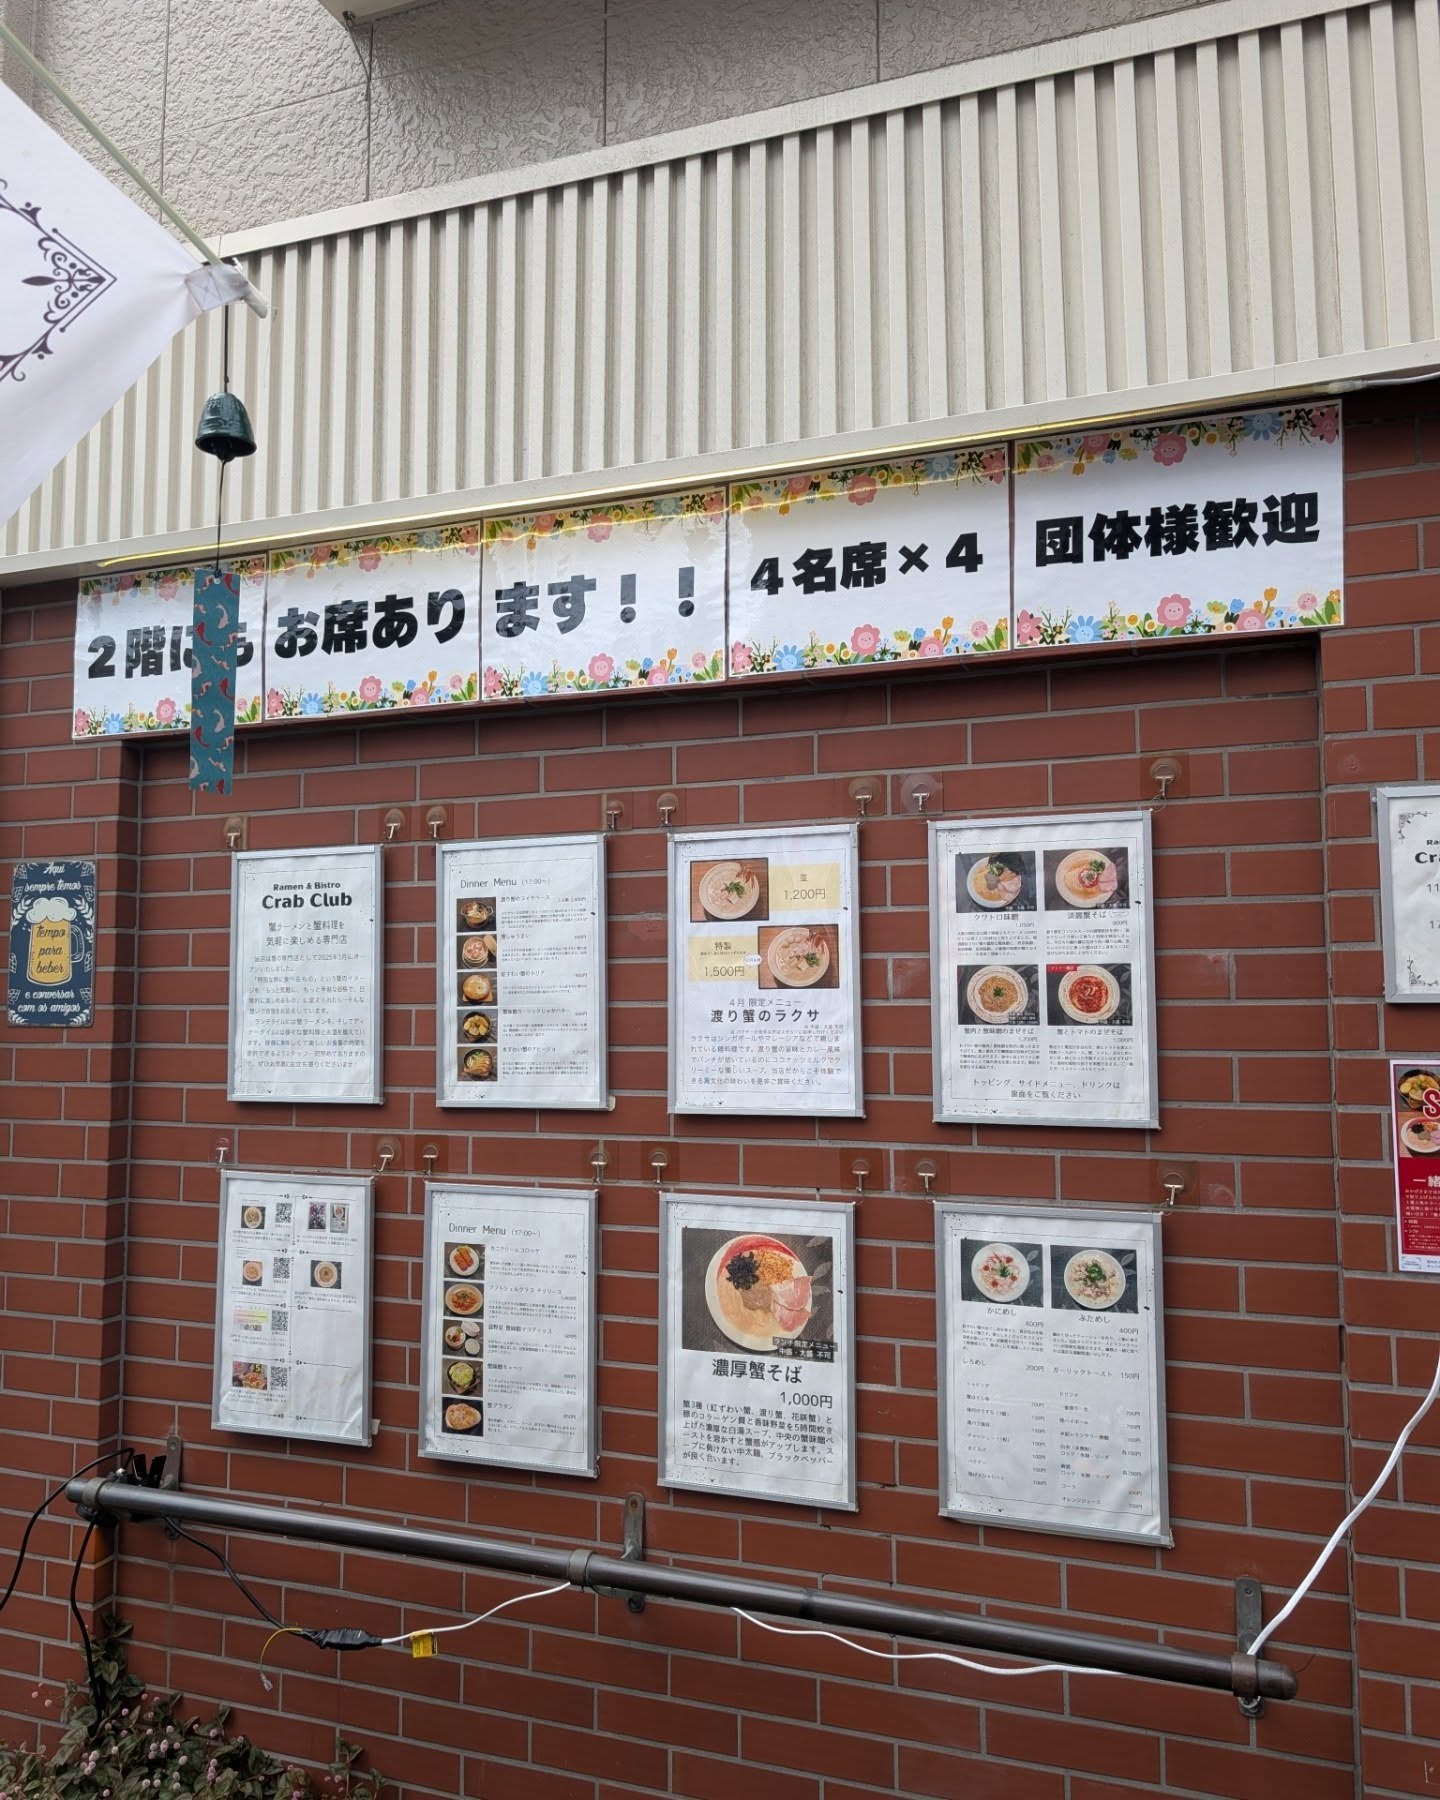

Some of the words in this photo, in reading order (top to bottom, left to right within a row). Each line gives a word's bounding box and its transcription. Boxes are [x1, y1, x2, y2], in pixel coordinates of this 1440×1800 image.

[274, 589, 466, 659] お席あり
[1034, 491, 1321, 567] 団体様歓迎
[1415, 851, 1440, 864] Cr
[24, 880, 56, 894] sempre
[57, 878, 82, 891] temos
[273, 883, 304, 891] Ramen
[314, 881, 341, 889] Bistro
[460, 880, 488, 889] Dinner
[493, 878, 517, 887] Menu
[262, 894, 304, 909] Crab
[310, 892, 353, 907] Club
[784, 888, 826, 901] 1,200円
[36, 925, 66, 941] tempo
[715, 941, 732, 951] 特製
[38, 947, 62, 959] para
[36, 961, 65, 974] beber
[704, 966, 745, 977] 1,500円
[24, 991, 31, 999] e
[32, 989, 75, 1000] conversar
[17, 1004, 36, 1013] com
[38, 1004, 48, 1013] os
[50, 1004, 81, 1016] amigos
[711, 1009, 820, 1023] 渡り蟹のラクサ
[448, 1223, 477, 1234] Dinner
[482, 1225, 506, 1236] Menu
[987, 1307, 1017, 1317] かにめし
[1025, 1320, 1044, 1328] 400円
[1078, 1314, 1111, 1325] ぶためし
[774, 1339, 836, 1349] ランチ限定メニュー
[712, 1358, 802, 1383] 濃厚蟹そば
[962, 1358, 988, 1367] しろめし
[1025, 1365, 1045, 1373] 200円
[1053, 1367, 1113, 1378] ガーリックトースト
[1120, 1372, 1140, 1380] 150円
[780, 1392, 833, 1408] 1,000円
